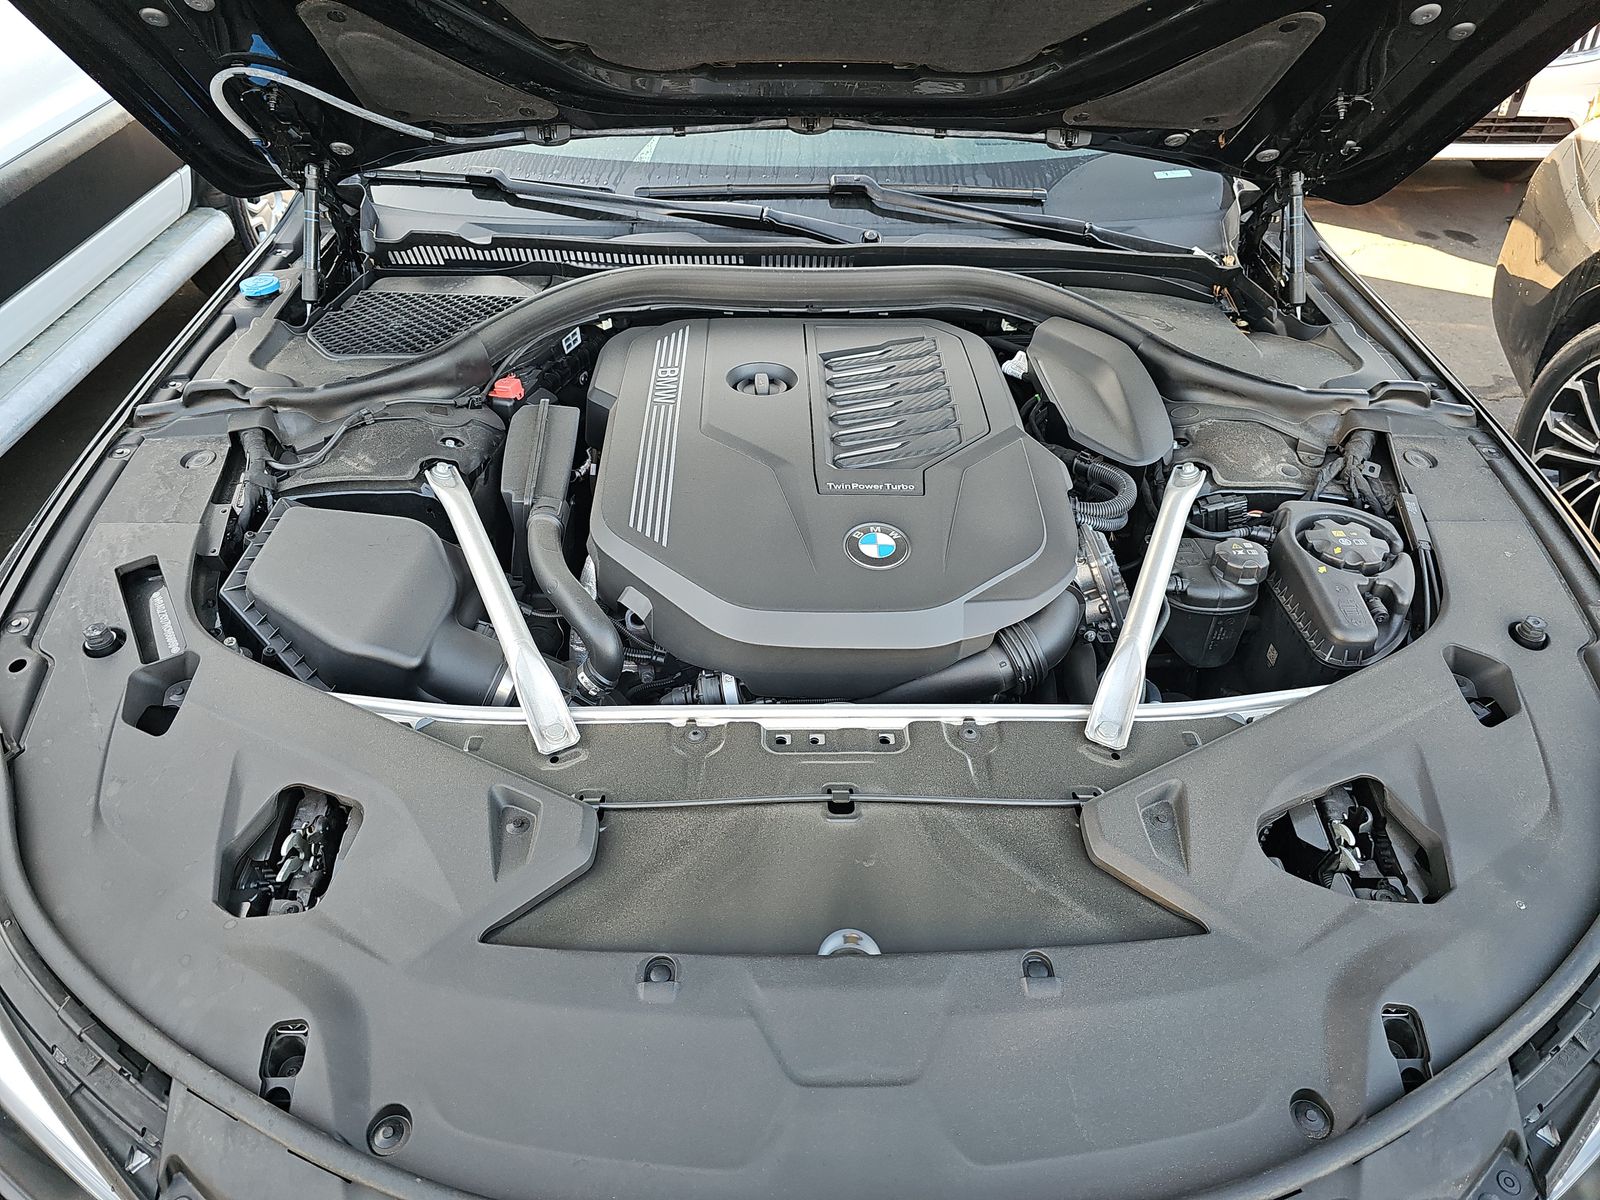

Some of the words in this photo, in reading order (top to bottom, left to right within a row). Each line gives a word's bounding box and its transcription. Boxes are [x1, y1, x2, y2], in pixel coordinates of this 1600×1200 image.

[652, 367, 680, 404] BMW
[883, 482, 915, 491] Turbo
[852, 526, 901, 540] BMW
